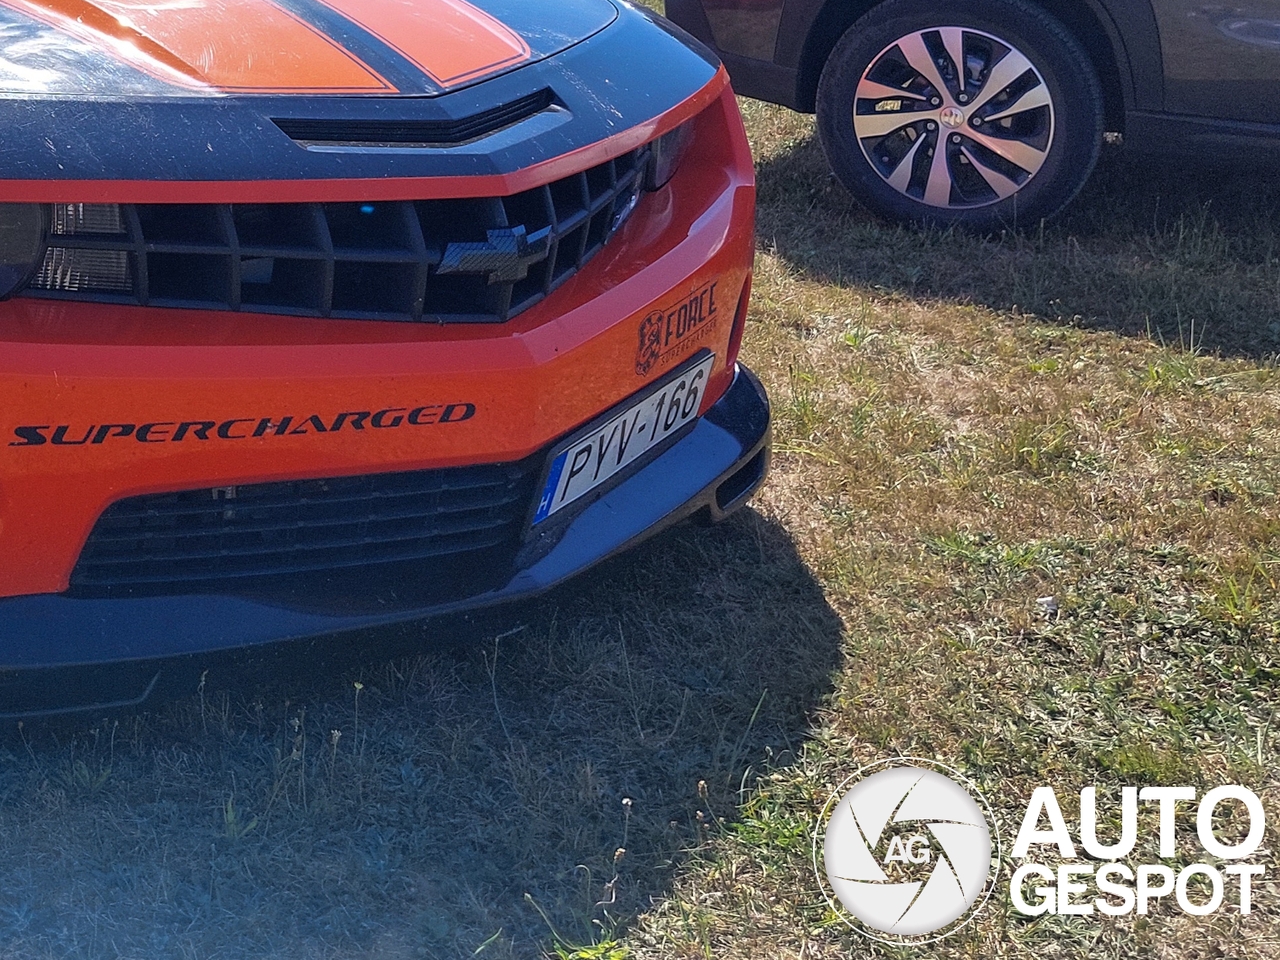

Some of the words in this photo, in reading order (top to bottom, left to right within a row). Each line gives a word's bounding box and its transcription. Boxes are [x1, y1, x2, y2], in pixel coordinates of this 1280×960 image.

[664, 280, 719, 347] FORCE
[8, 401, 478, 447] SUPERCHARGED
[537, 493, 552, 515] H
[560, 368, 704, 502] PYV-166
